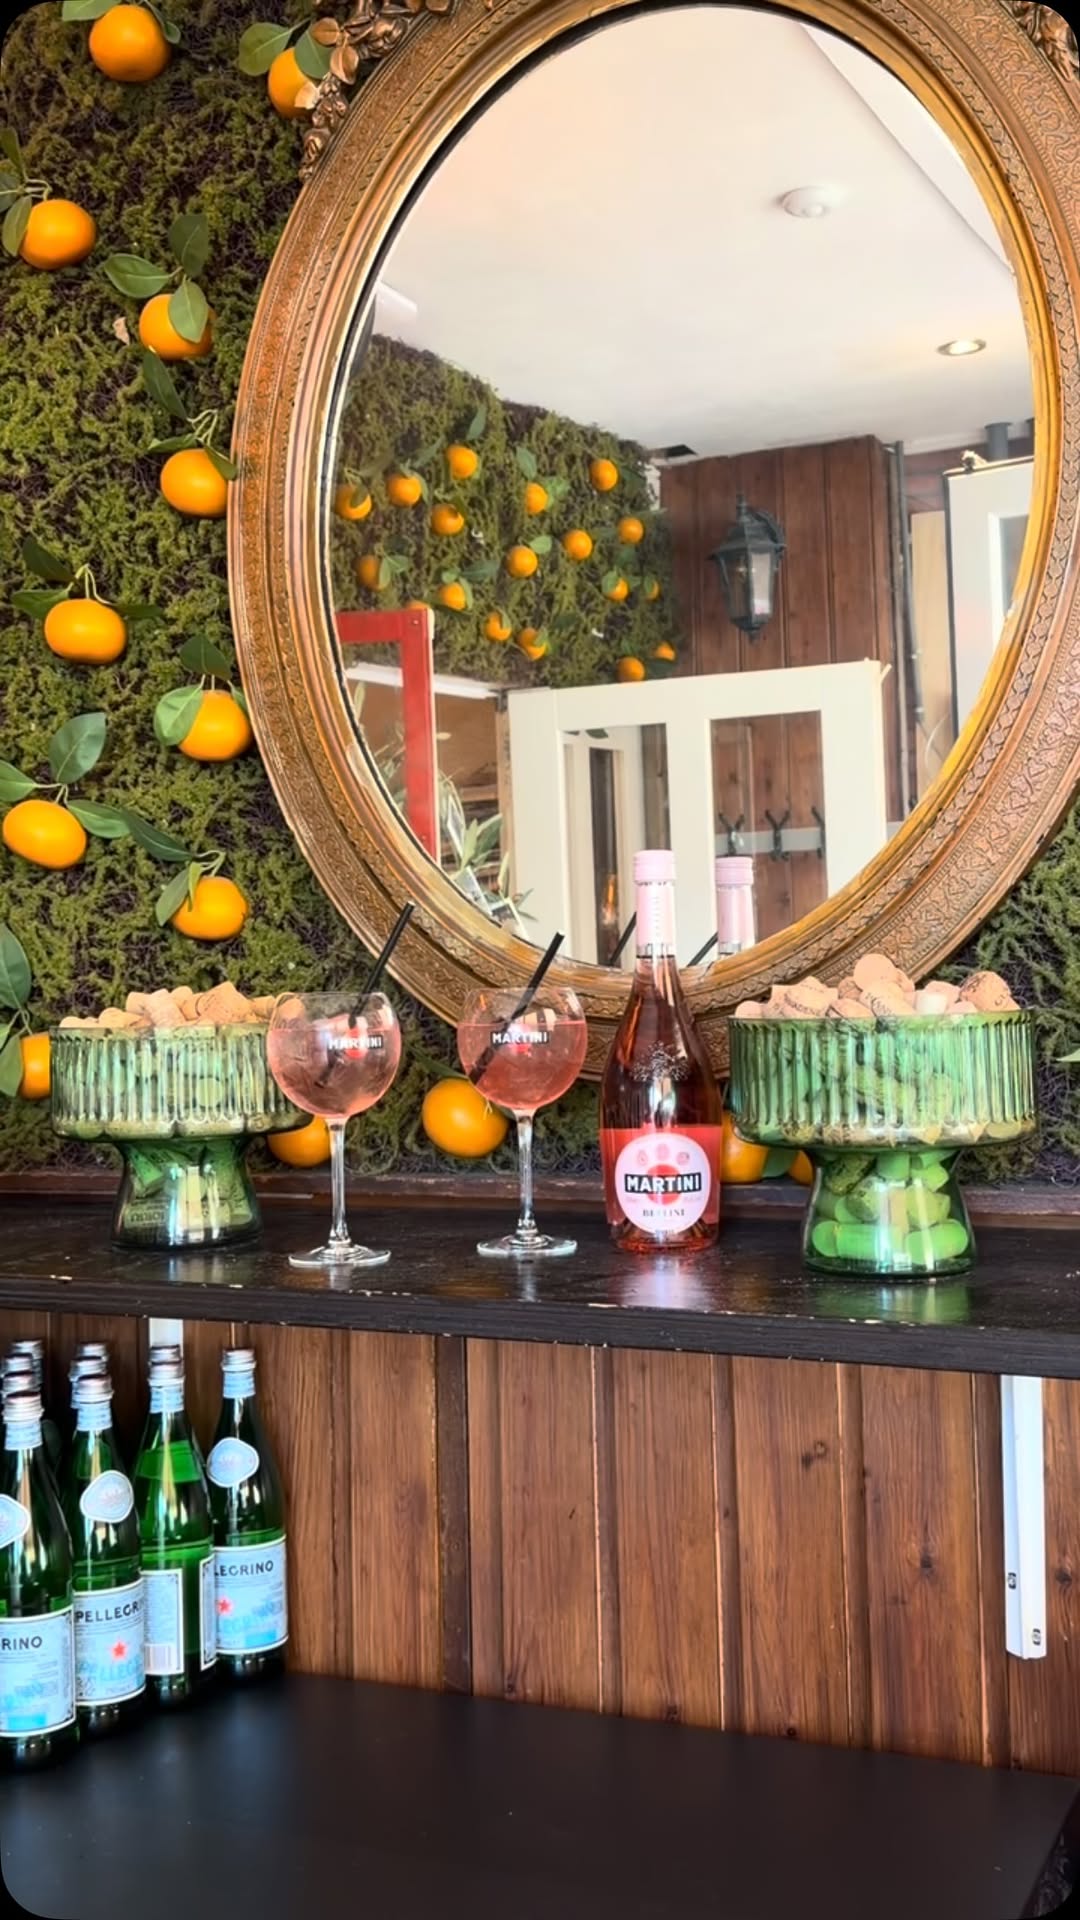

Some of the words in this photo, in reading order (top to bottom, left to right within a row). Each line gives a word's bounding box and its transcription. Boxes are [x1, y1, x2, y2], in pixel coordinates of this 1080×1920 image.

[328, 1035, 382, 1050] MARTINI
[492, 1031, 548, 1044] MARTINI
[626, 1173, 700, 1192] MARTINI
[643, 1208, 685, 1217] BEINI
[1, 1635, 43, 1651] RINO
